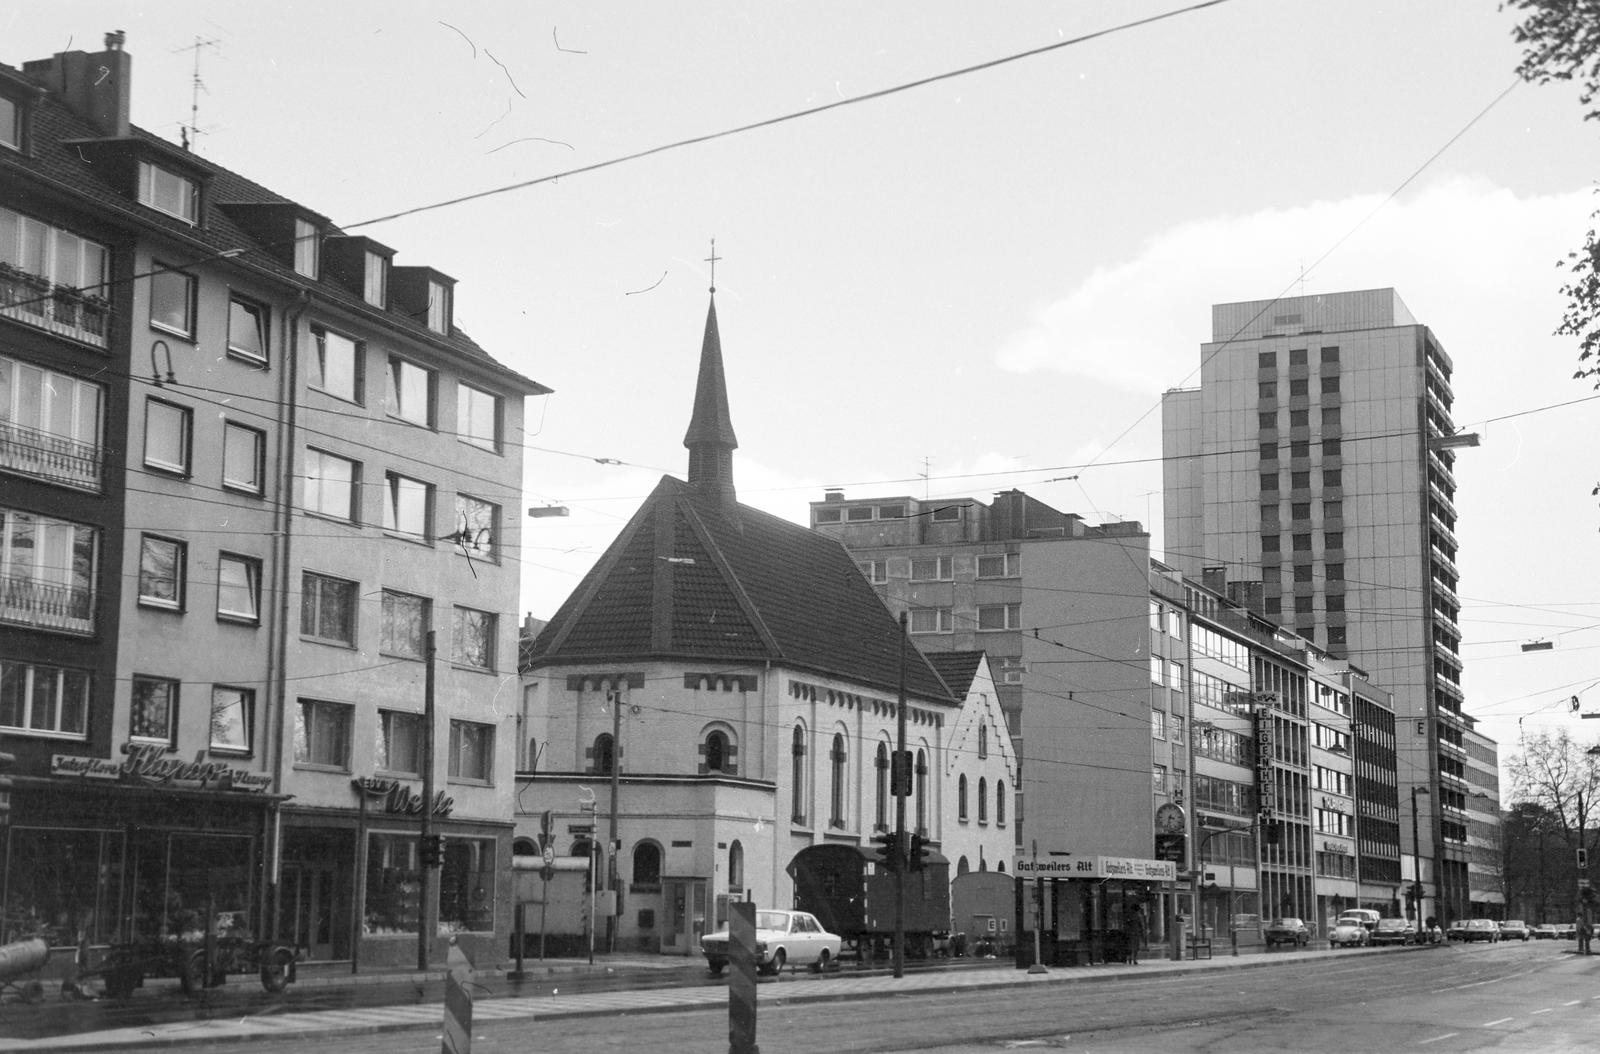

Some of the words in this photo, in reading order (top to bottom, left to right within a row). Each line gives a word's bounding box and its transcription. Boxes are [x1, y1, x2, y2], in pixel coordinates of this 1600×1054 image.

[1261, 708, 1272, 818] EIGENHEIM
[388, 780, 455, 815] Wele
[1077, 861, 1093, 872] Alt
